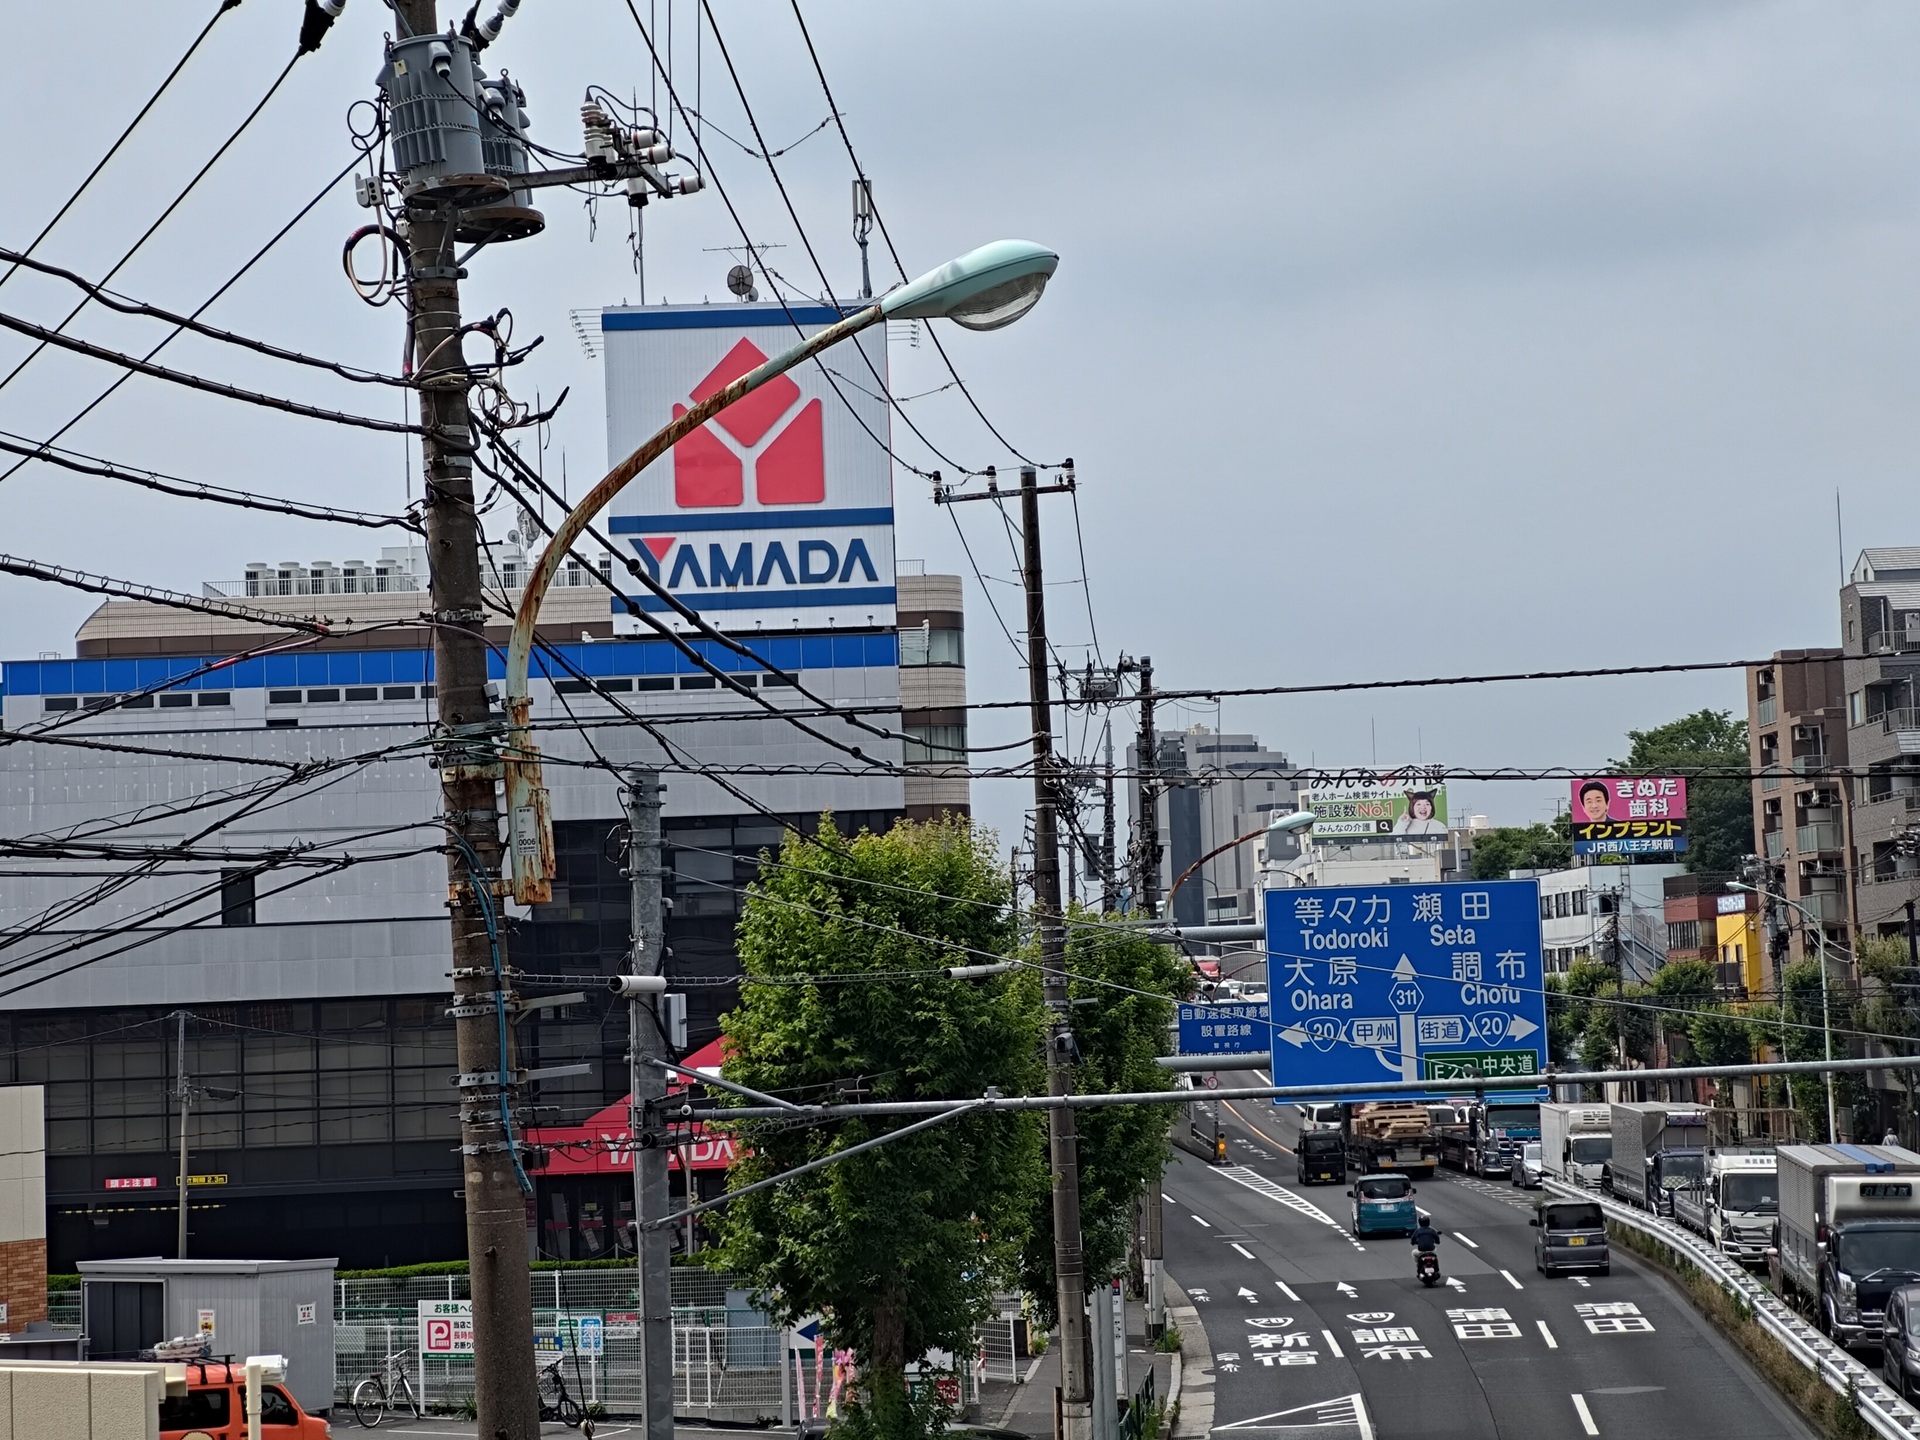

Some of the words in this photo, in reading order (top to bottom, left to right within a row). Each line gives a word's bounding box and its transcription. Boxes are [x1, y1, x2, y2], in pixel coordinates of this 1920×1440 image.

[628, 537, 879, 588] YAMADA
[1311, 763, 1446, 789] みんなの介護
[1312, 791, 1392, 801] 老人ホーム検索サイト
[1616, 778, 1678, 798] きぬた
[1628, 798, 1669, 817] 歯科
[1318, 823, 1371, 832] みんなの介護
[1579, 820, 1682, 839] インプラント
[1587, 839, 1674, 853] JR西八王子駅前
[1294, 894, 1391, 927] 等々力
[1412, 891, 1490, 923] 瀬田
[1300, 927, 1389, 951] Todoroki
[1430, 924, 1476, 947] Seta
[1284, 956, 1359, 988] 大原
[1452, 949, 1527, 982] 調布
[1291, 989, 1353, 1012] Ohara
[1460, 983, 1521, 1006] Chofu
[1396, 989, 1417, 1006] 311
[1201, 1024, 1252, 1037] 設置路線
[1313, 1022, 1334, 1042] 20
[1356, 1022, 1395, 1042] 甲州
[1420, 1021, 1461, 1040] 街道
[1481, 1017, 1502, 1036] 20
[1482, 1054, 1534, 1075] 中央道
[1248, 1331, 1319, 1367] 新宿
[1351, 1326, 1433, 1360] 調布
